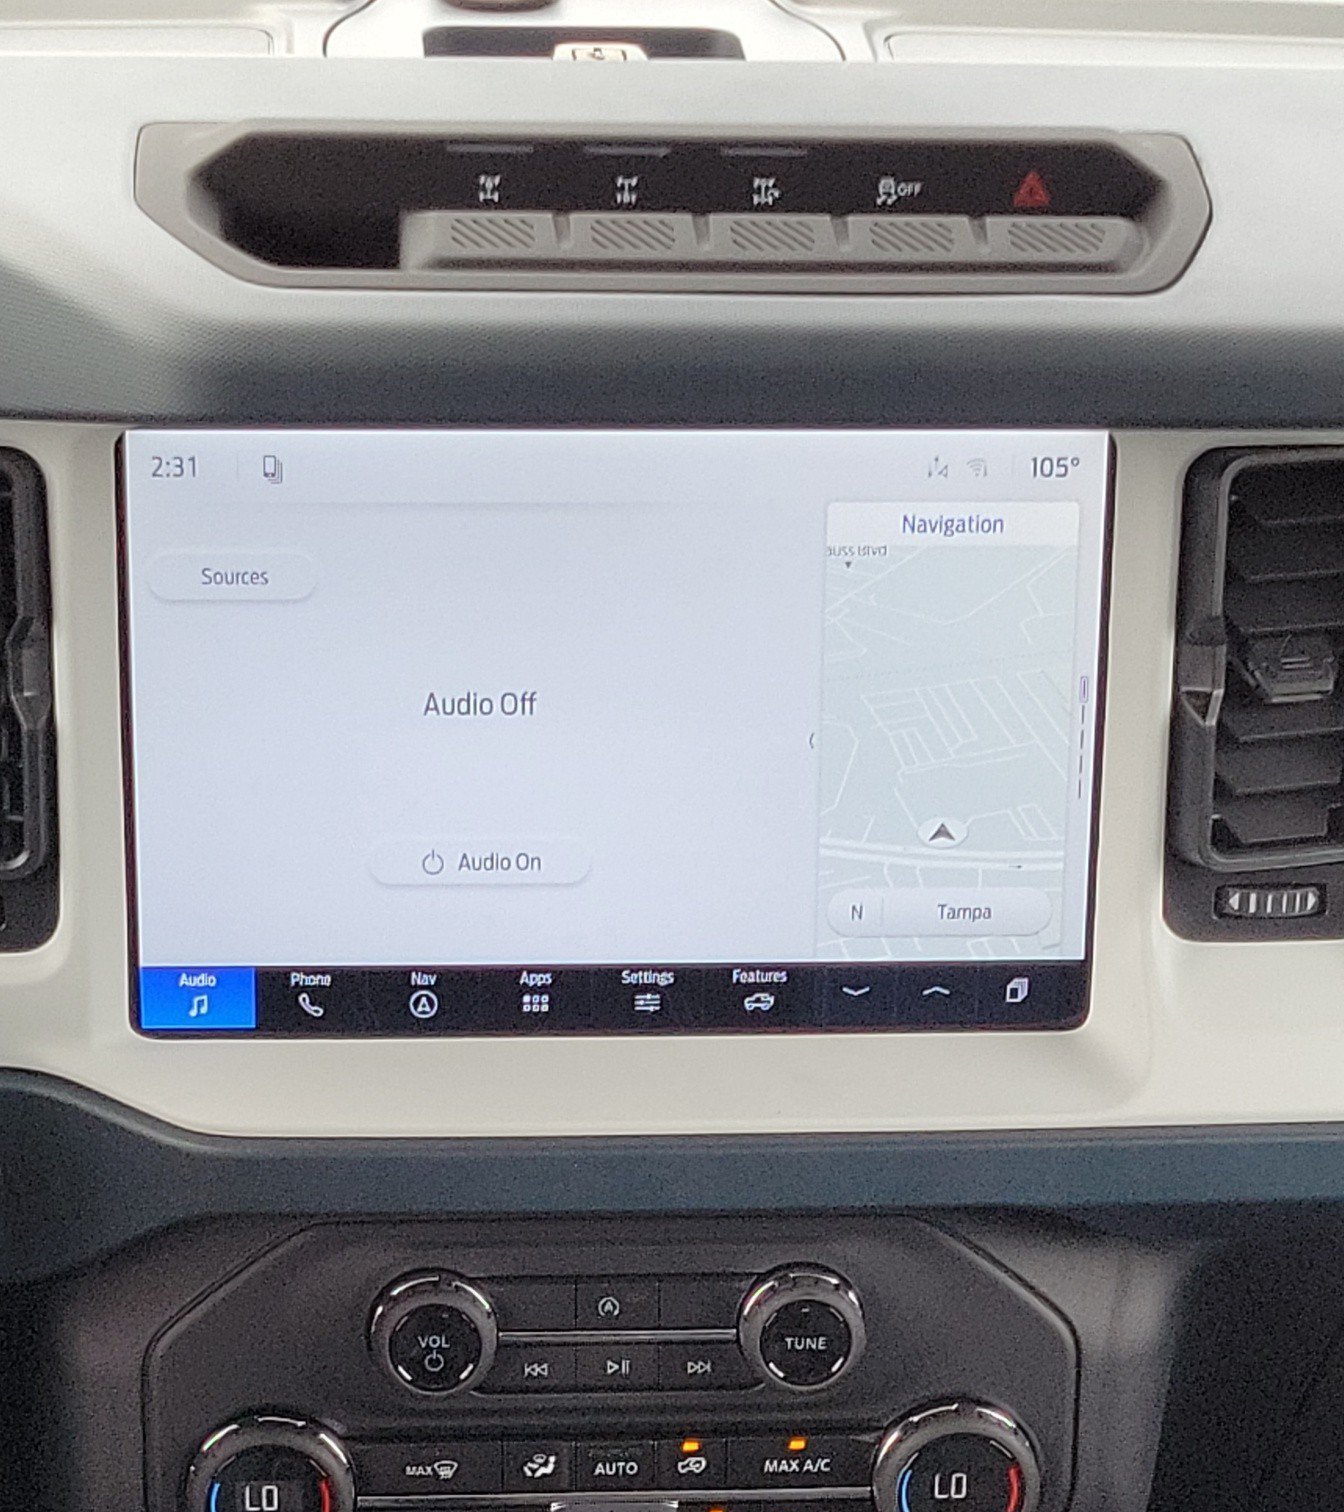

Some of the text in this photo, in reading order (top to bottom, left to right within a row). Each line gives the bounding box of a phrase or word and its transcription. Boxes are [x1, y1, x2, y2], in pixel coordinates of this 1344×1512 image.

[151, 455, 198, 479] 2:31
[1030, 455, 1081, 479] 105°
[901, 514, 1004, 538] Navigation
[201, 566, 269, 586] Sources
[423, 690, 537, 717] Audio Off
[458, 852, 542, 872] Audio On
[850, 905, 864, 921] N
[938, 904, 993, 923] Tampa
[179, 972, 217, 988] Audio
[290, 972, 332, 988] Phone
[411, 972, 437, 987] Nav
[519, 971, 552, 988] Apps
[621, 969, 674, 987] Settings
[732, 969, 788, 984] Features
[417, 1335, 450, 1350] VOL
[784, 1337, 827, 1351] TUNE
[405, 1464, 433, 1477] MAX
[593, 1462, 638, 1477] AUTO
[764, 1458, 831, 1474] MAX A/C
[933, 1472, 967, 1500] LO
[244, 1484, 279, 1512] LO
